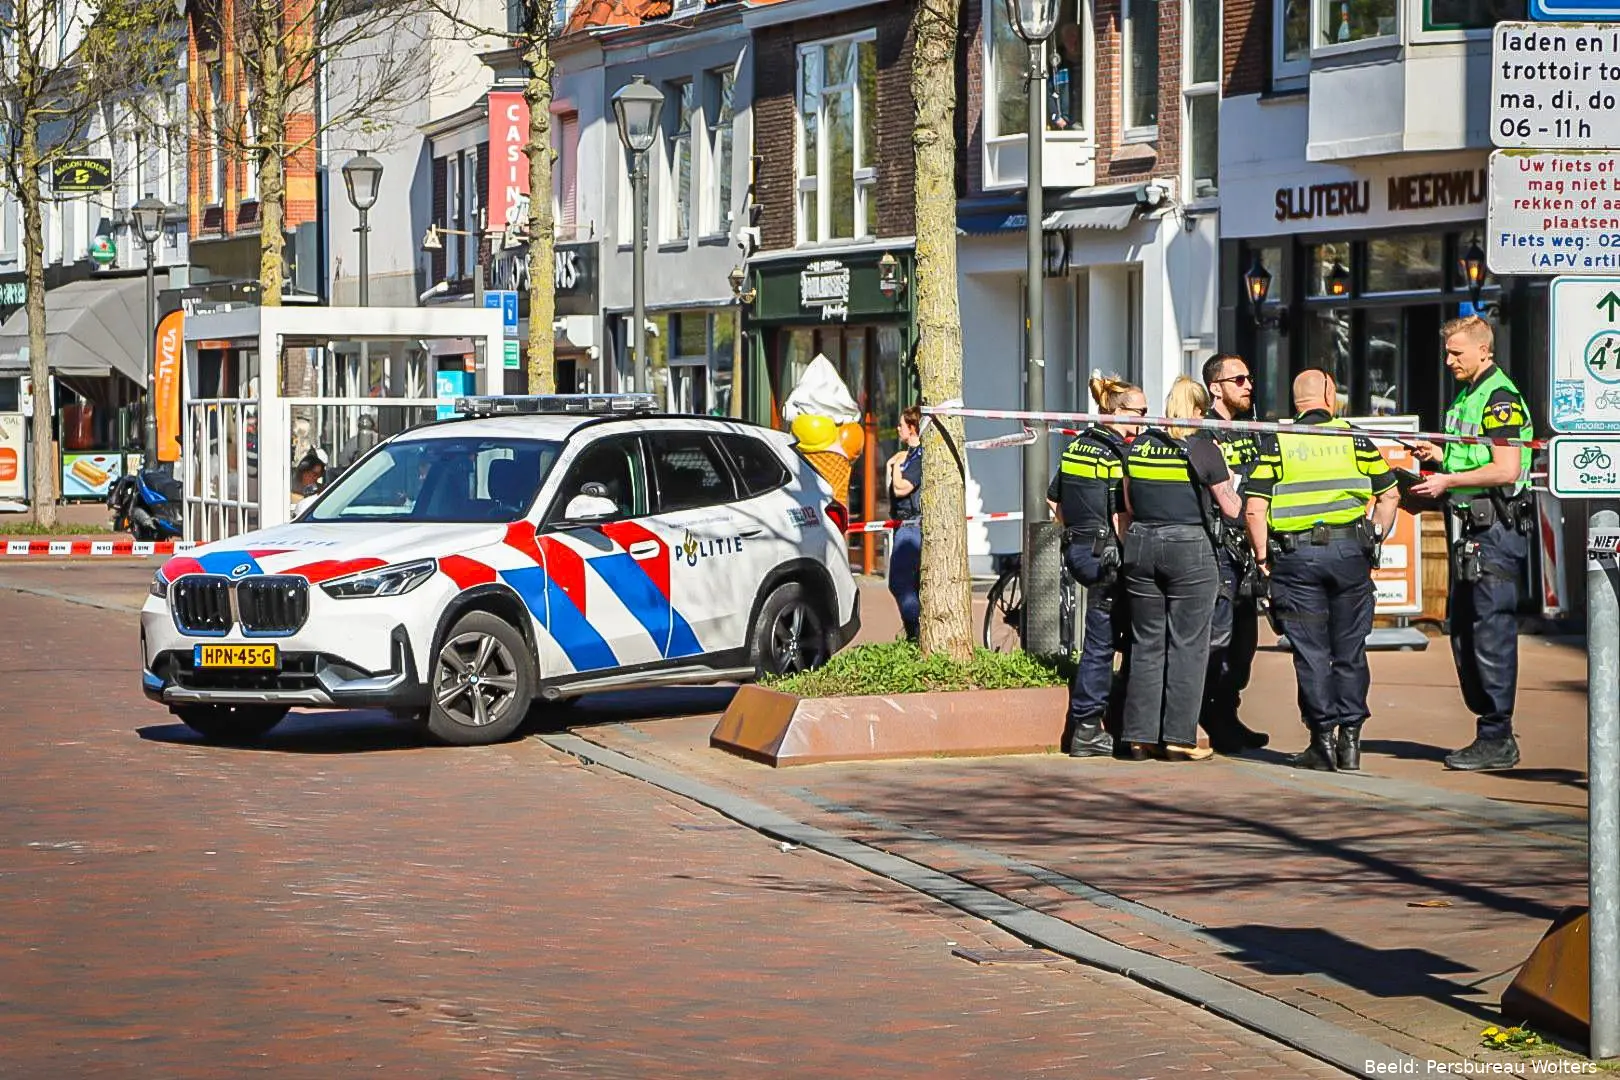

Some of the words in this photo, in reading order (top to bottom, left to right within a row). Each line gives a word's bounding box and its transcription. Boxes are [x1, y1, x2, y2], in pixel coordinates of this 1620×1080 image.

[1502, 32, 1566, 52] laden
[1576, 36, 1603, 52] en
[1502, 61, 1592, 80] trottoir
[1599, 63, 1620, 80] to
[1500, 93, 1543, 110] ma,
[1551, 90, 1580, 110] di,
[1588, 90, 1615, 109] do
[1500, 118, 1531, 137] 06
[1579, 118, 1591, 137] h
[1519, 159, 1544, 172] Uw
[1552, 159, 1592, 172] fiets
[1598, 159, 1614, 172] of
[1528, 180, 1564, 194] mag
[1572, 178, 1607, 191] niet
[1514, 197, 1573, 210] rekken
[1580, 197, 1596, 210] of
[1543, 216, 1619, 231] plaatsen
[1501, 233, 1545, 247] Fiets
[1551, 236, 1590, 251] weg:
[1598, 234, 1620, 247] 02
[1532, 253, 1577, 267] (APV
[1287, 441, 1349, 461] POLITIE
[675, 533, 744, 567] POLITIE
[1593, 535, 1620, 548] NIET
[205, 648, 271, 664] HPN-45-G
